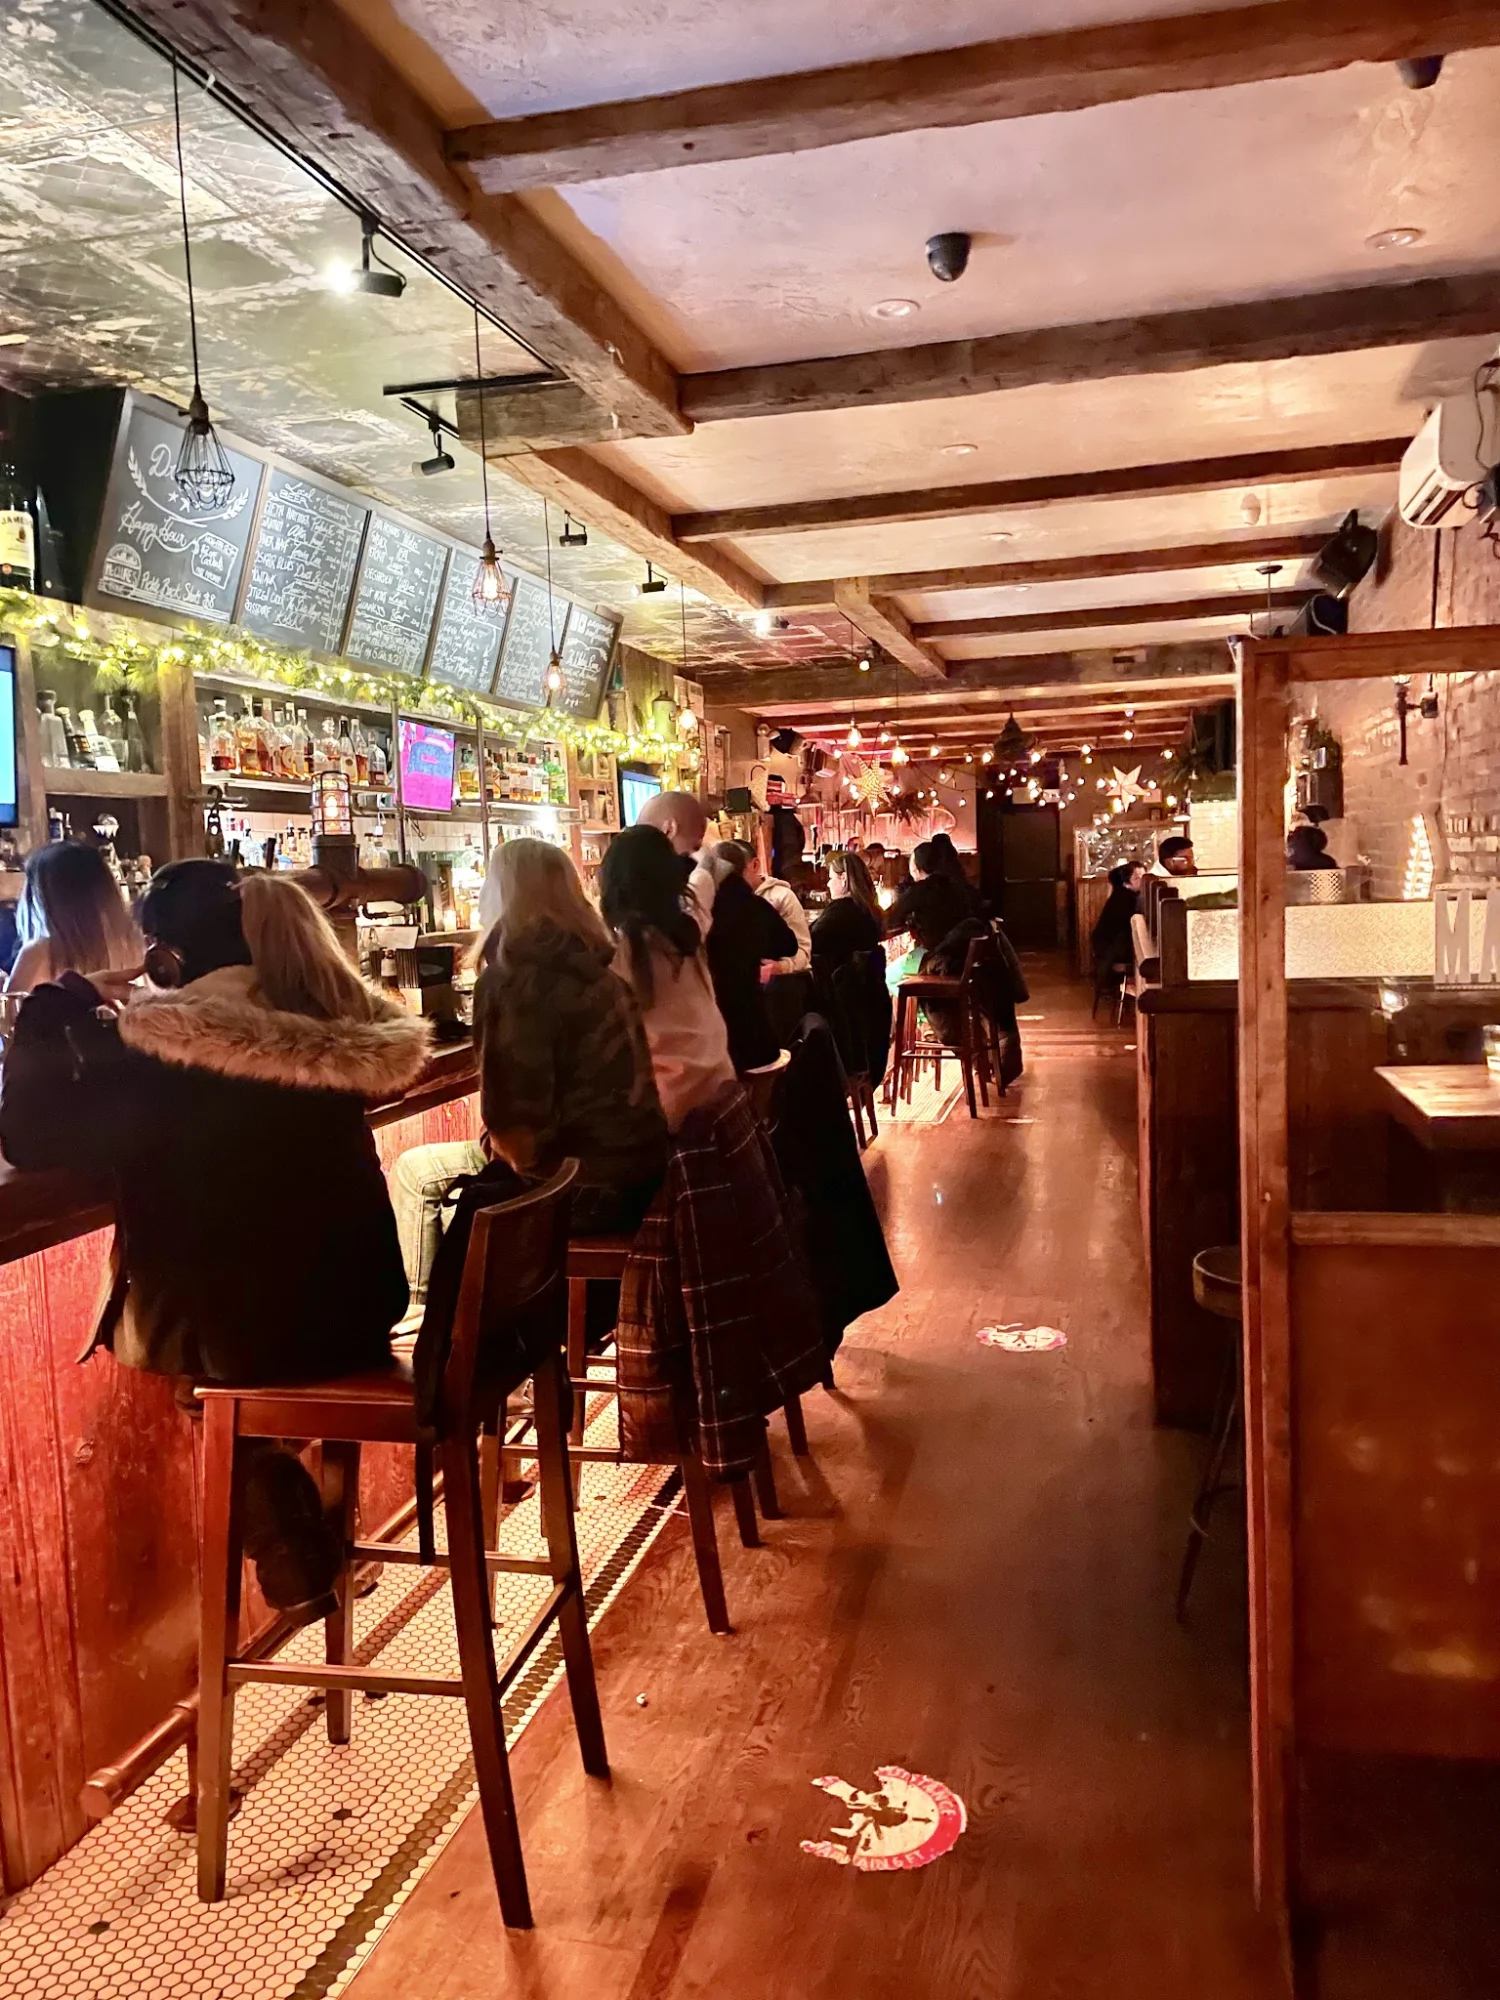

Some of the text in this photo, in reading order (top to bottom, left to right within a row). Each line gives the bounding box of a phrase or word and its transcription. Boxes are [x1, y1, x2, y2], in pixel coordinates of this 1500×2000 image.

[118, 500, 188, 552] Happy Hour
[892, 1856, 904, 1868] 6
[904, 1849, 925, 1865] FT
